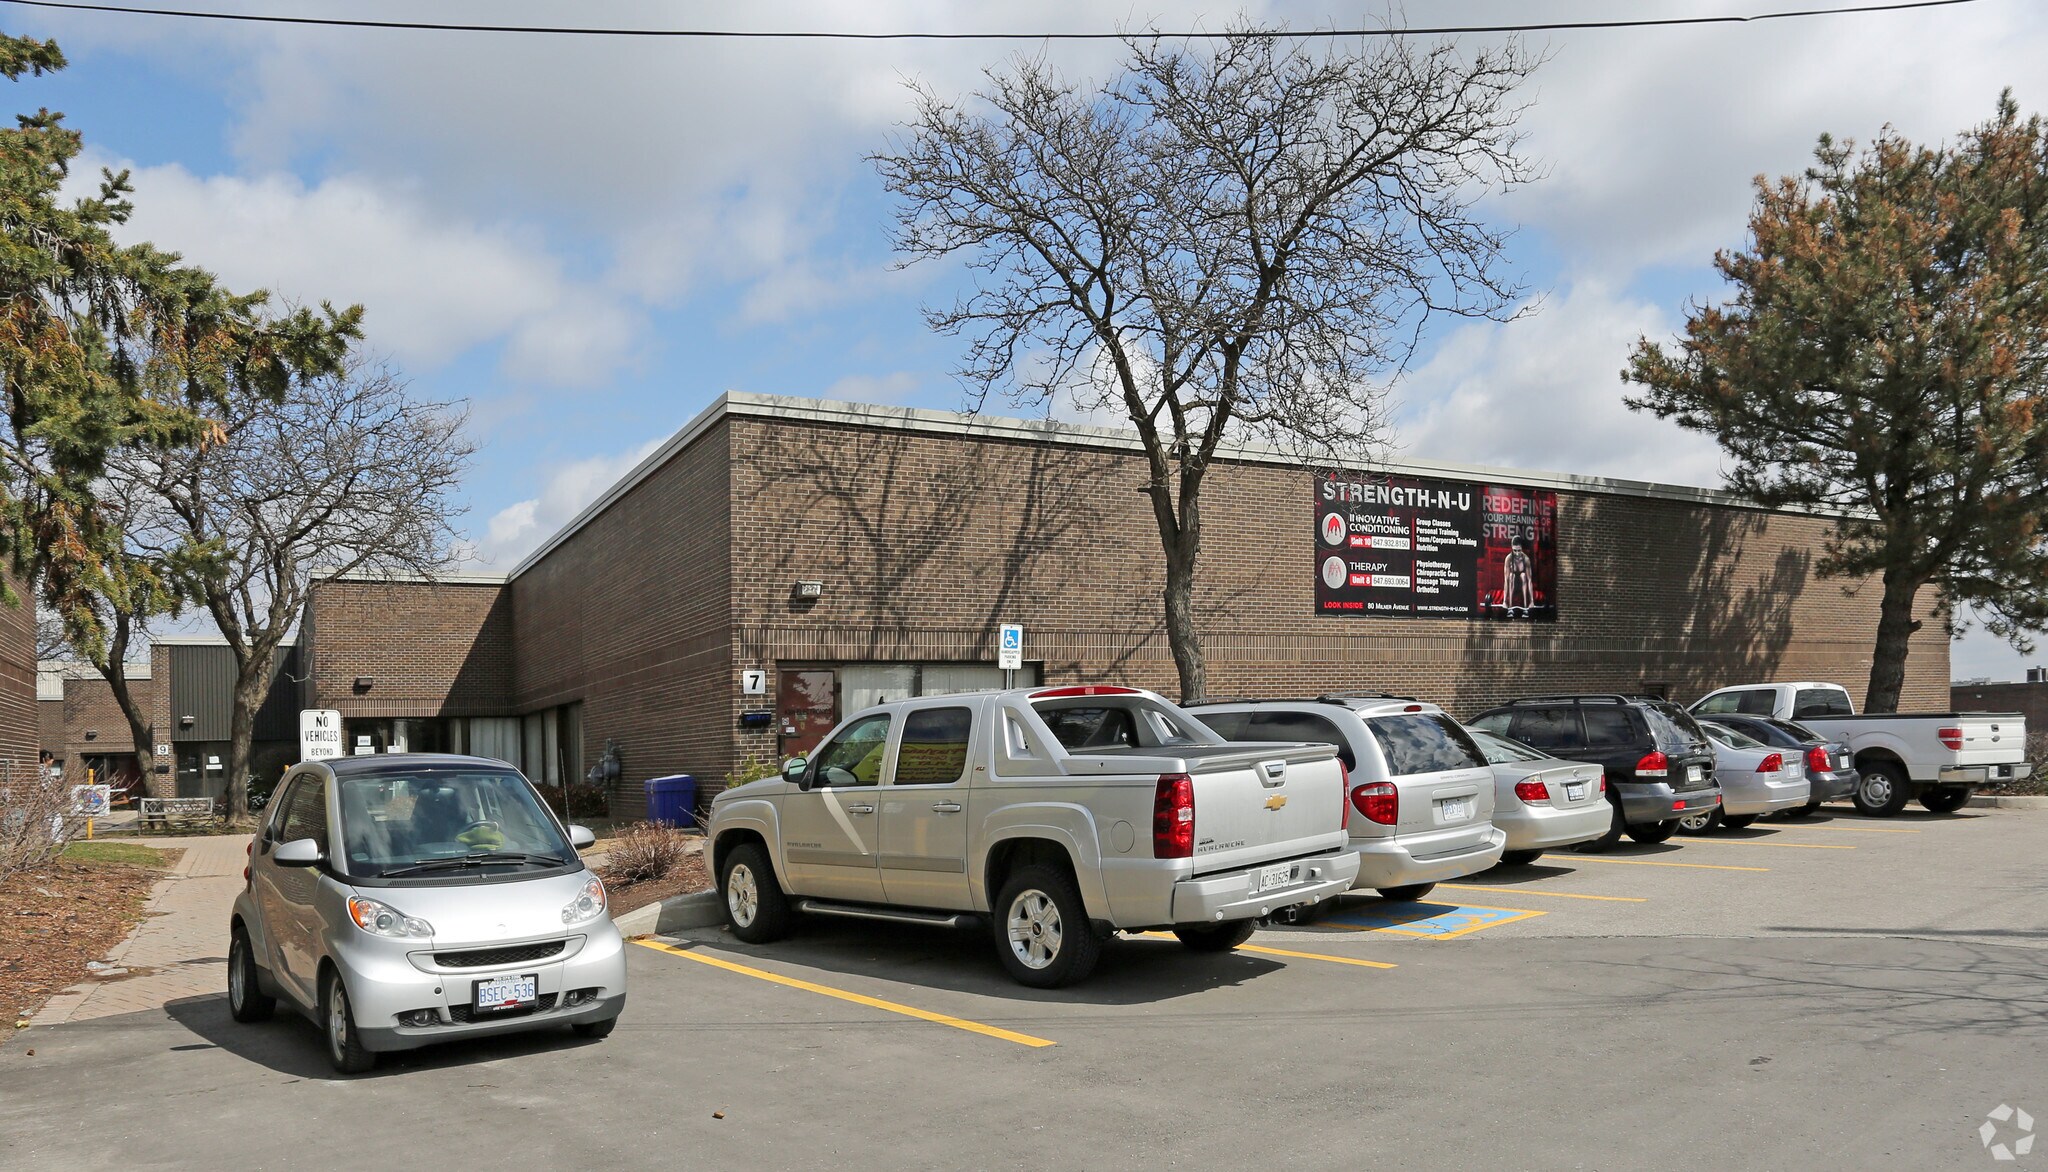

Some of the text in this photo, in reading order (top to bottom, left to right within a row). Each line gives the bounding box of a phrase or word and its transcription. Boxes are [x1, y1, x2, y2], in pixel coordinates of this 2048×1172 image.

[1322, 481, 1470, 511] STRENGTH-N-U
[1482, 495, 1551, 516] REDEFINE
[1349, 513, 1401, 526] INNOVATIVE
[1416, 518, 1451, 527] Group Classes
[1482, 512, 1551, 526] YOUR MEANING OF
[1349, 523, 1410, 535] CONDITIONING
[1416, 527, 1459, 537] Personal Training
[1482, 523, 1551, 542] STRENGTH
[1351, 536, 1409, 548] Unit 10 647.932.8150
[1416, 535, 1477, 547] Team/Corporate Training
[1349, 562, 1388, 572] THERAPY
[1416, 560, 1451, 570] Physiotherapy
[1416, 569, 1447, 577] Chiropractic
[1352, 575, 1365, 584] Unit
[1365, 576, 1371, 585] 8
[1416, 577, 1459, 587] Massage Therapy
[749, 674, 760, 690] 7
[315, 716, 329, 728] NO
[304, 731, 338, 742] VEHICLES
[159, 746, 167, 754] 9
[310, 748, 334, 756] BEYOND
[1198, 840, 1245, 853] AVALANCHE
[480, 983, 534, 1003] BSEC 536
